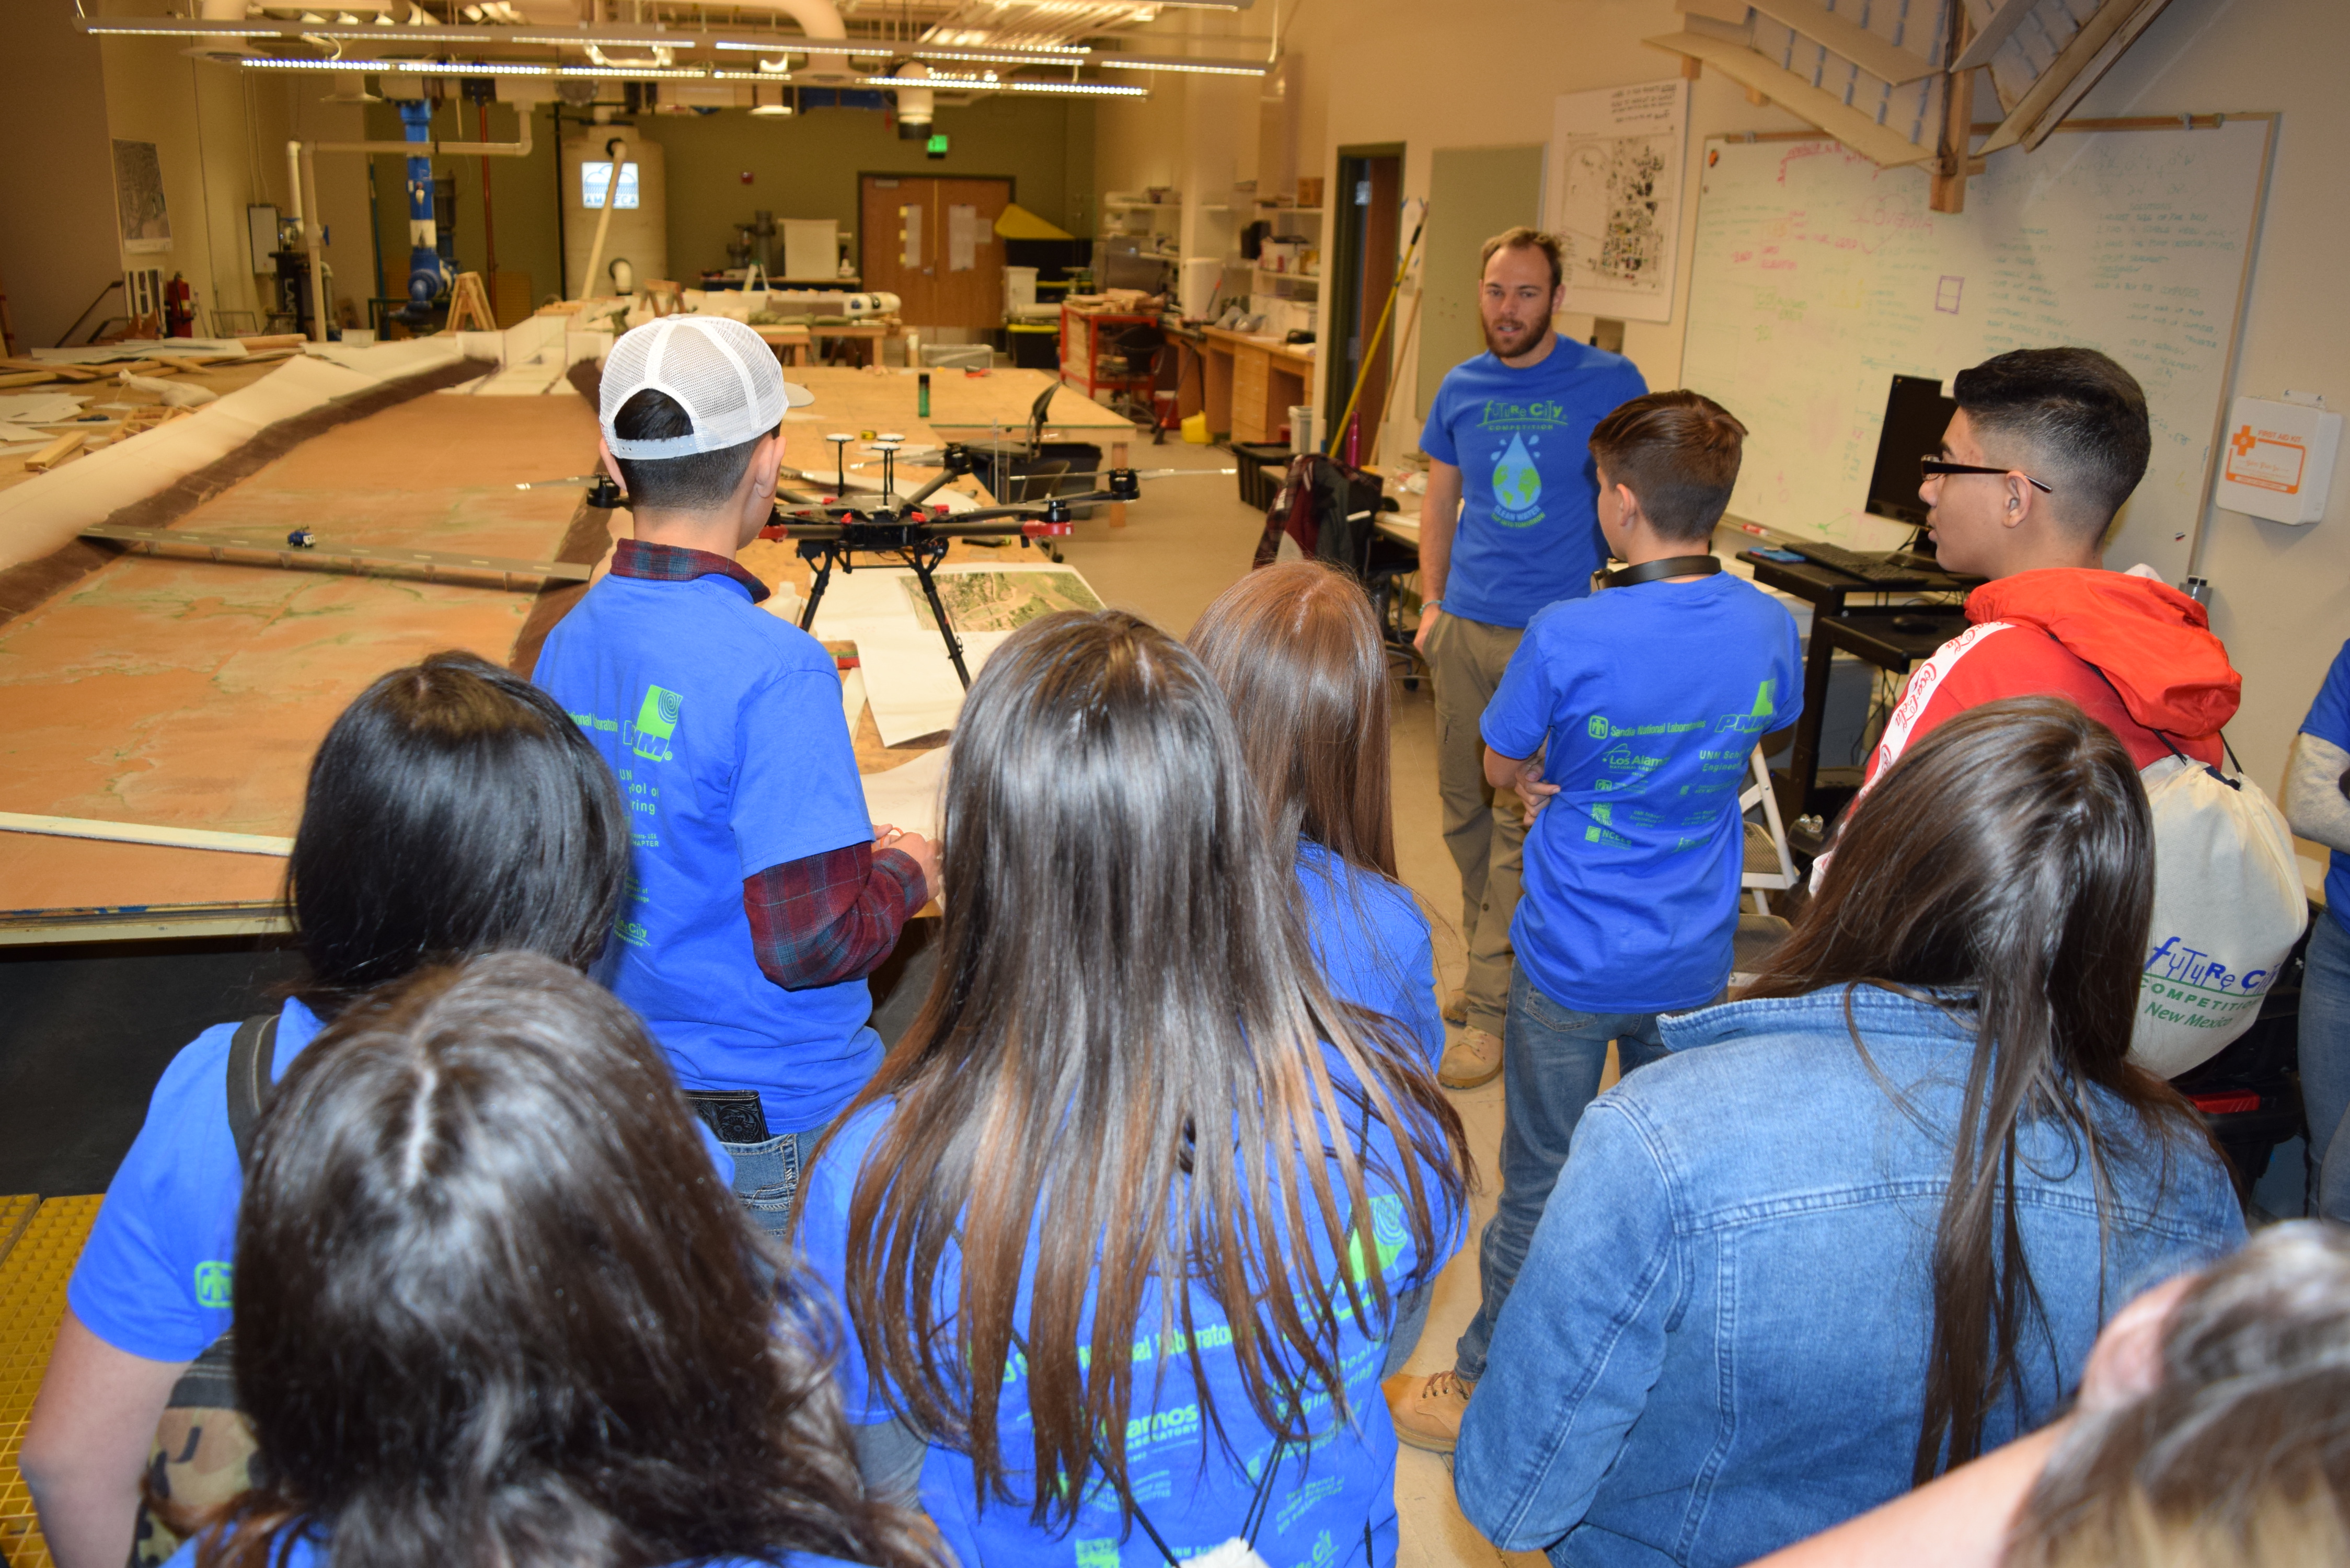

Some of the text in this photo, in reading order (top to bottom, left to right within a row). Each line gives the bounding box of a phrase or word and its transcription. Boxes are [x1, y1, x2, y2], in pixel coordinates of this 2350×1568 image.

[585, 195, 637, 204] AMFCA
[1610, 725, 1635, 737] Sandia
[1637, 723, 1666, 735] National
[1609, 756, 1630, 765] Los
[1700, 750, 1721, 760] UNM
[619, 768, 632, 781] UN
[2144, 1001, 2234, 1029] New Mexico
[1125, 1403, 1199, 1439] amos
[1125, 1423, 1199, 1450] ABORATORY
